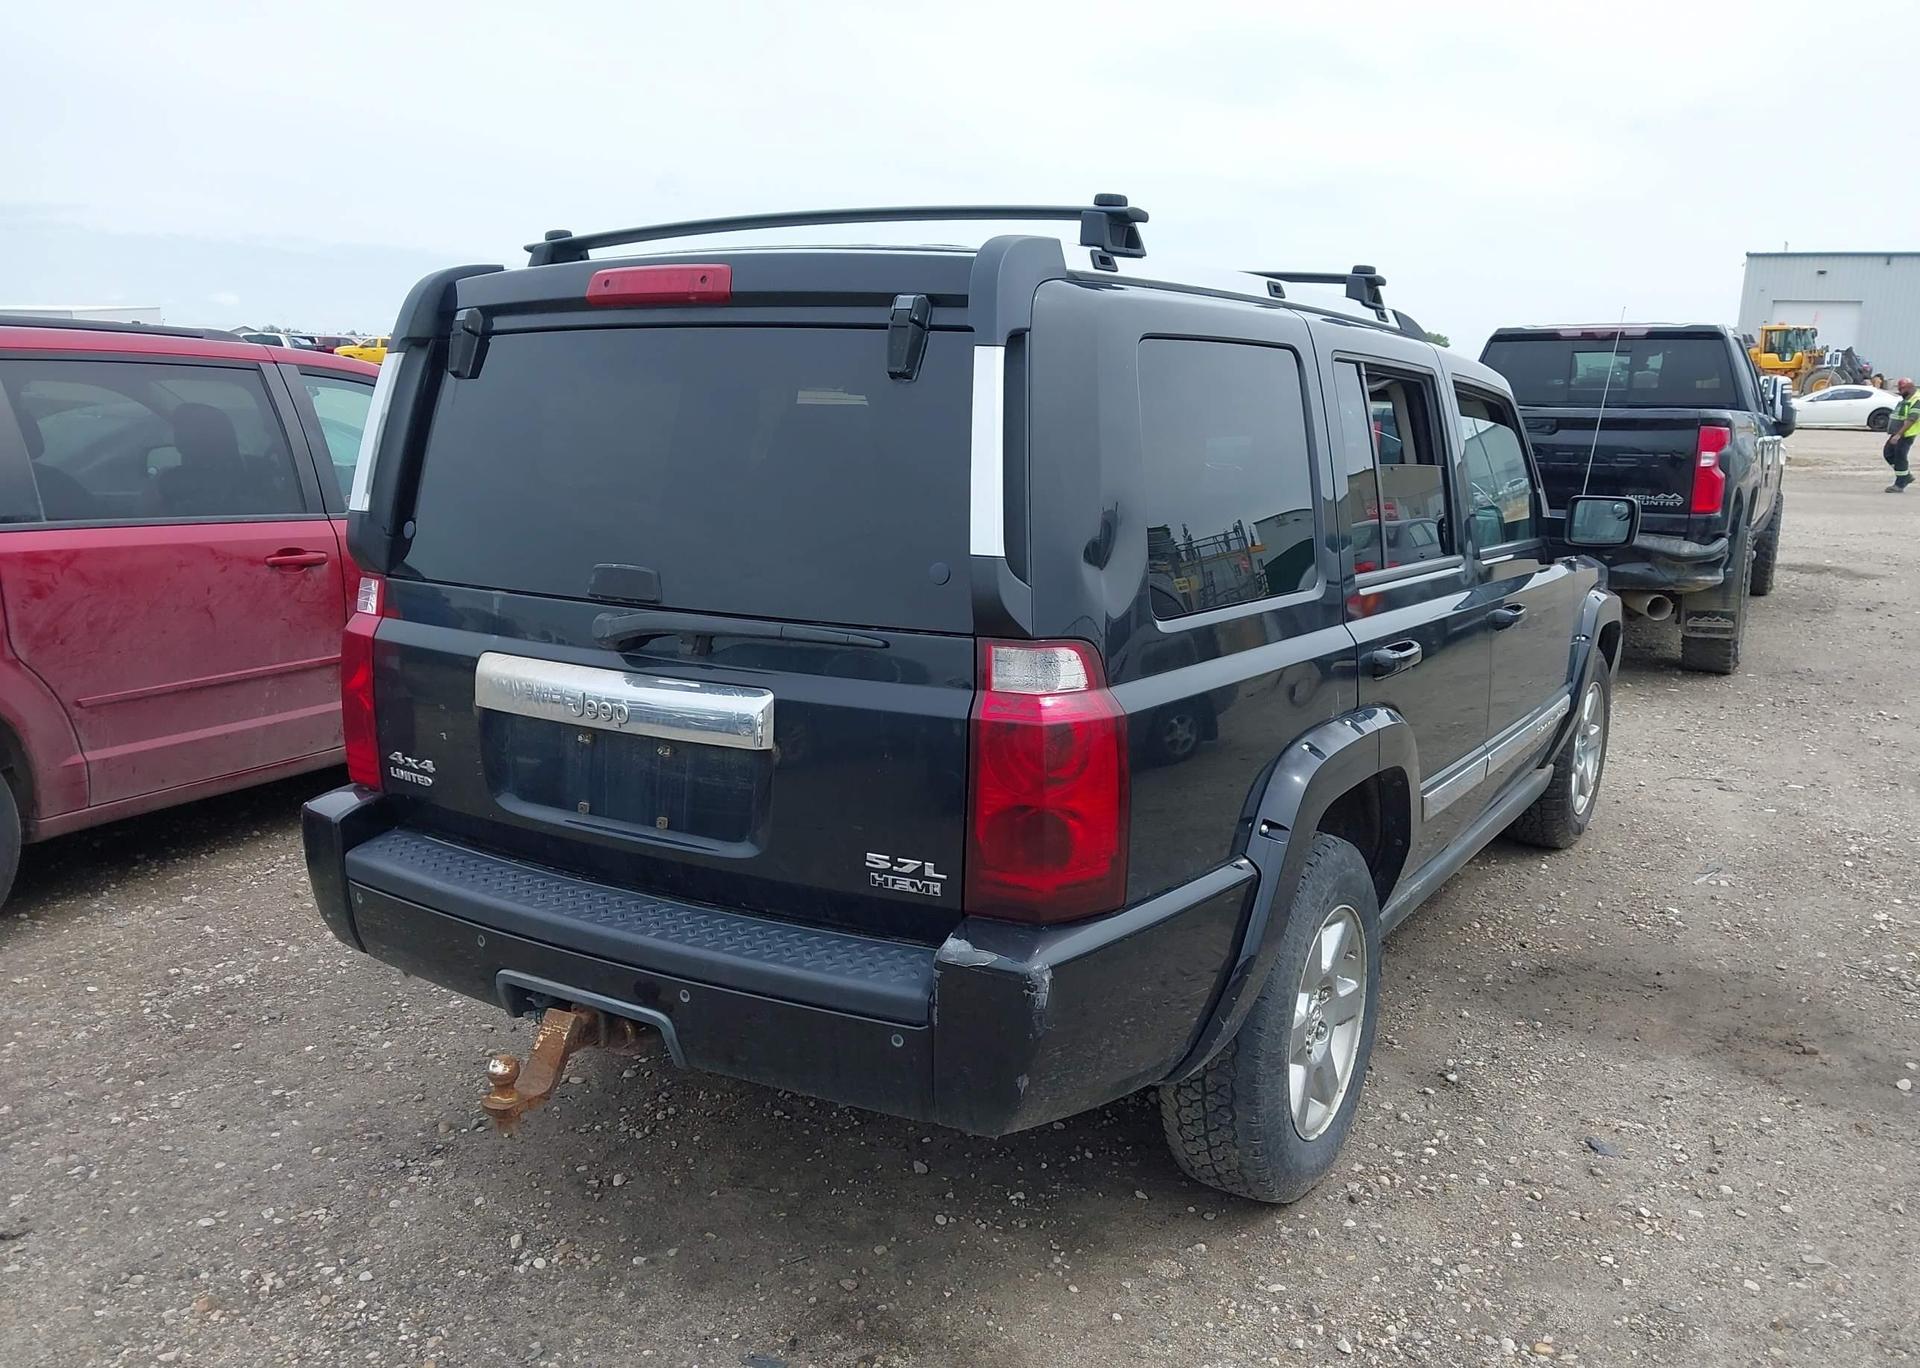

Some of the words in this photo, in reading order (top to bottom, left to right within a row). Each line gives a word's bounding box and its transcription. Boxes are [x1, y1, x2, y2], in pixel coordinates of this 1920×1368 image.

[567, 691, 631, 728] Jeep
[390, 766, 433, 787] LIMITED
[865, 852, 948, 880] 5.7L
[870, 872, 942, 897] HEMI
